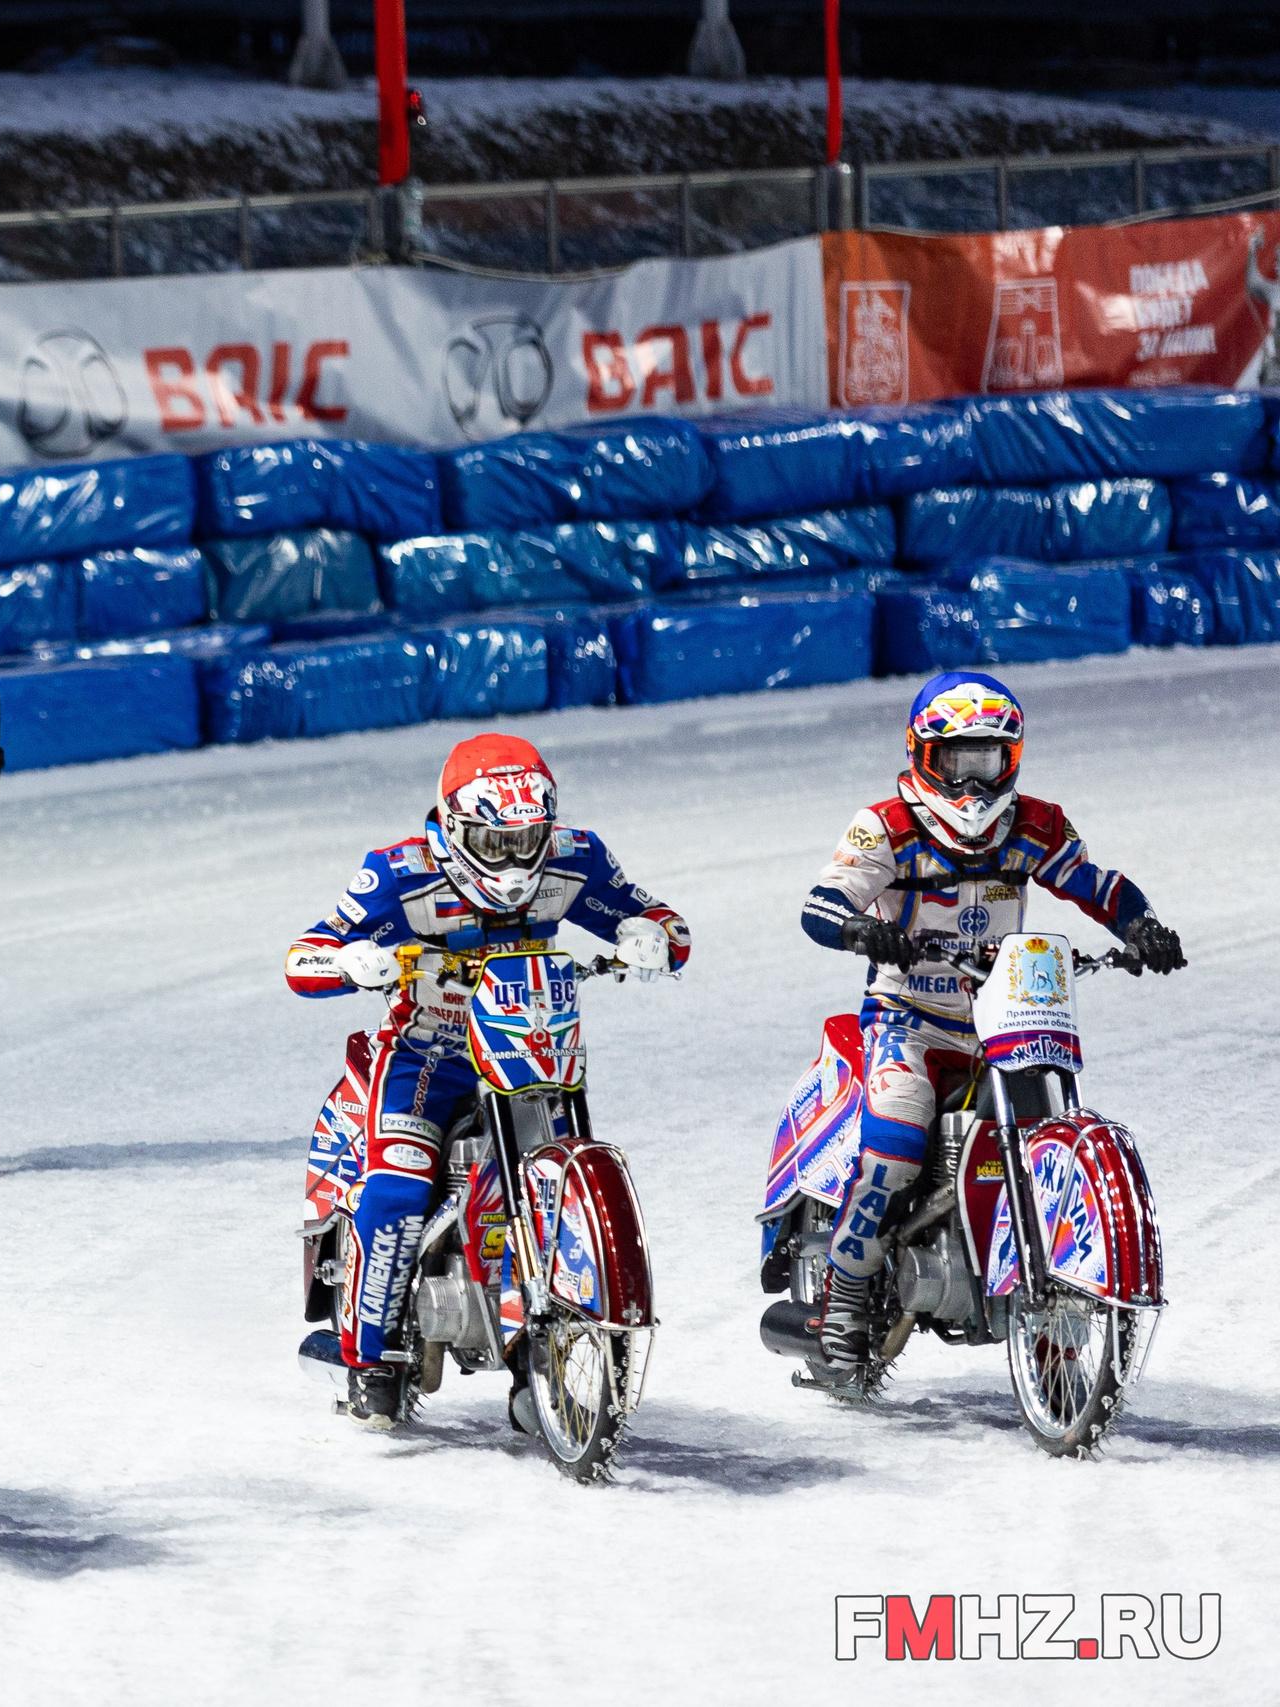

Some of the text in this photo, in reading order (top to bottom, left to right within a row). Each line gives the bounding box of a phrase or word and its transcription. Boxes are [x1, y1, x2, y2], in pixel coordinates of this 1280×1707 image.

[144, 340, 350, 433] BAIC
[582, 312, 774, 412] BAIC
[509, 805, 539, 815] Arai
[340, 898, 362, 917] COTT
[494, 980, 576, 1009] ЦТ ВС
[908, 974, 959, 994] MEGA
[482, 1049, 533, 1061] Каменск
[837, 1163, 891, 1261] LADA
[360, 1224, 398, 1327] КАМЕНСК-
[384, 1215, 425, 1335] УРАЛЬСКИЙ
